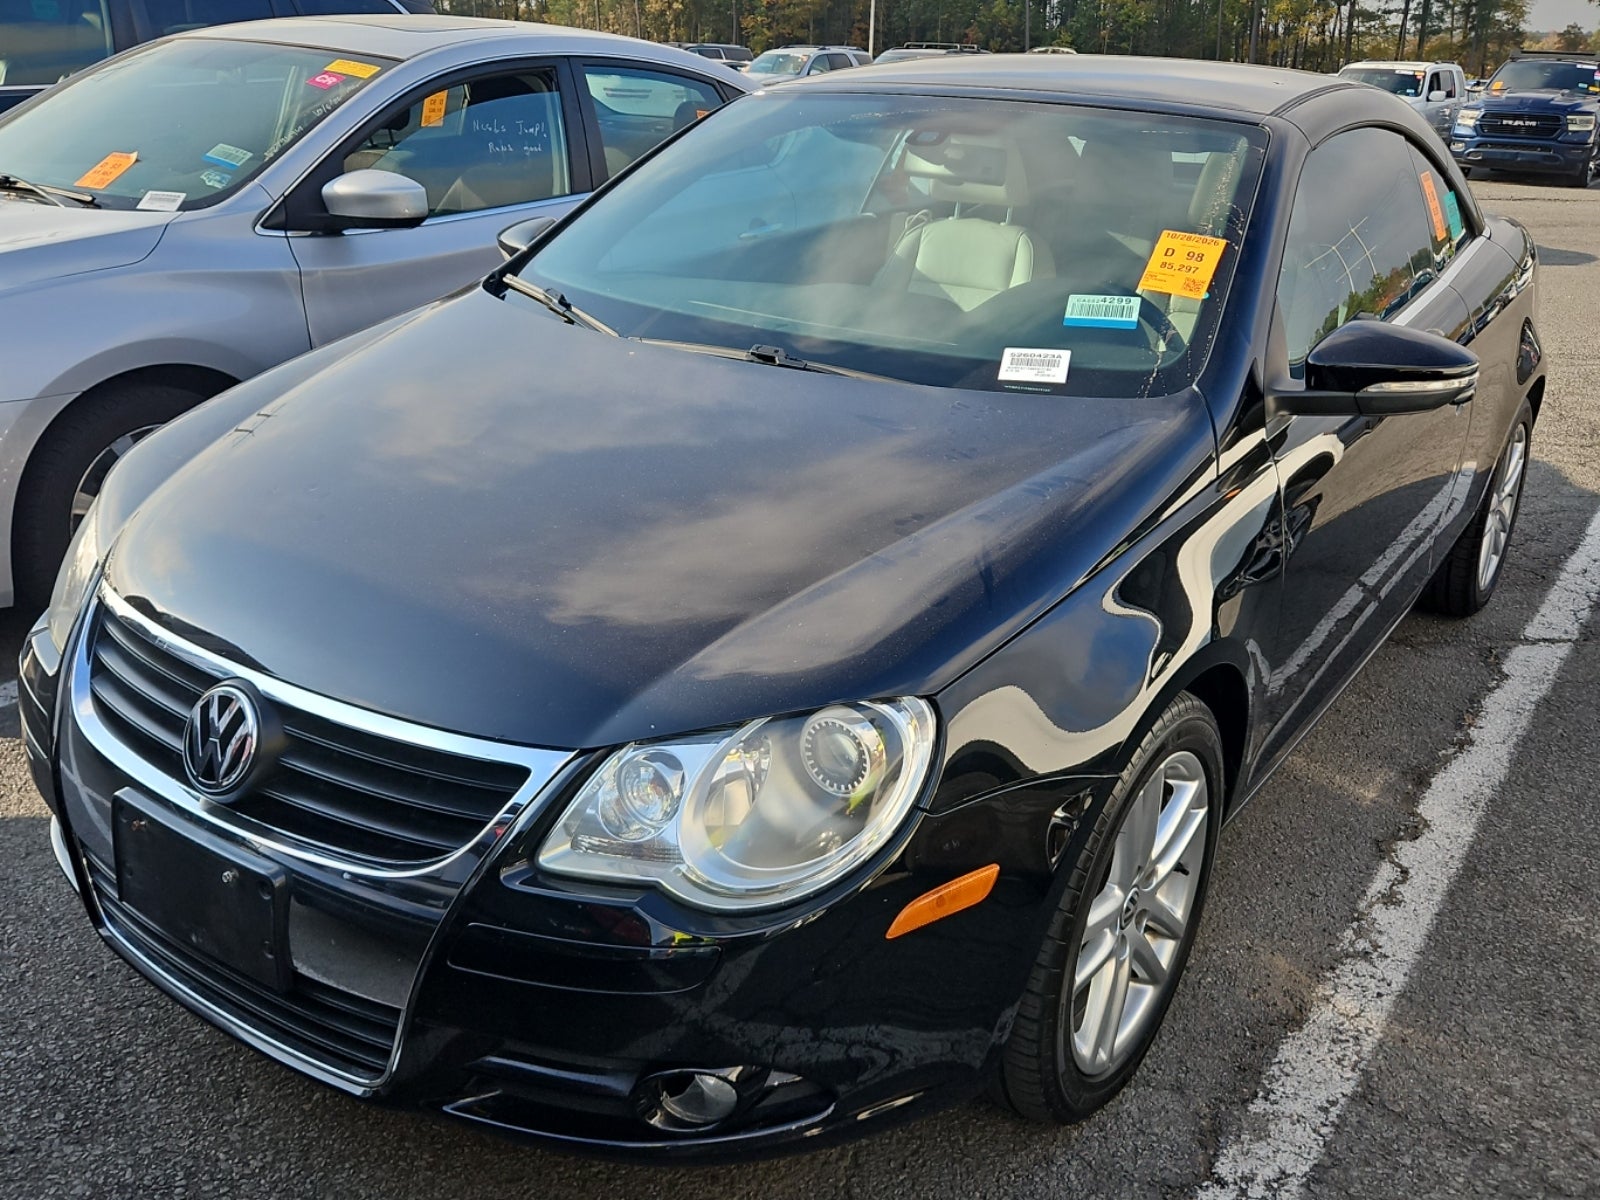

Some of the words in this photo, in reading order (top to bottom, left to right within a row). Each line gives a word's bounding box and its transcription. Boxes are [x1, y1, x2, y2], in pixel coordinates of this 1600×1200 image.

[315, 75, 338, 85] CR
[1165, 232, 1220, 247] 10/28/2026
[1163, 247, 1176, 257] D
[1186, 250, 1205, 263] 98
[188, 687, 256, 789] VW
